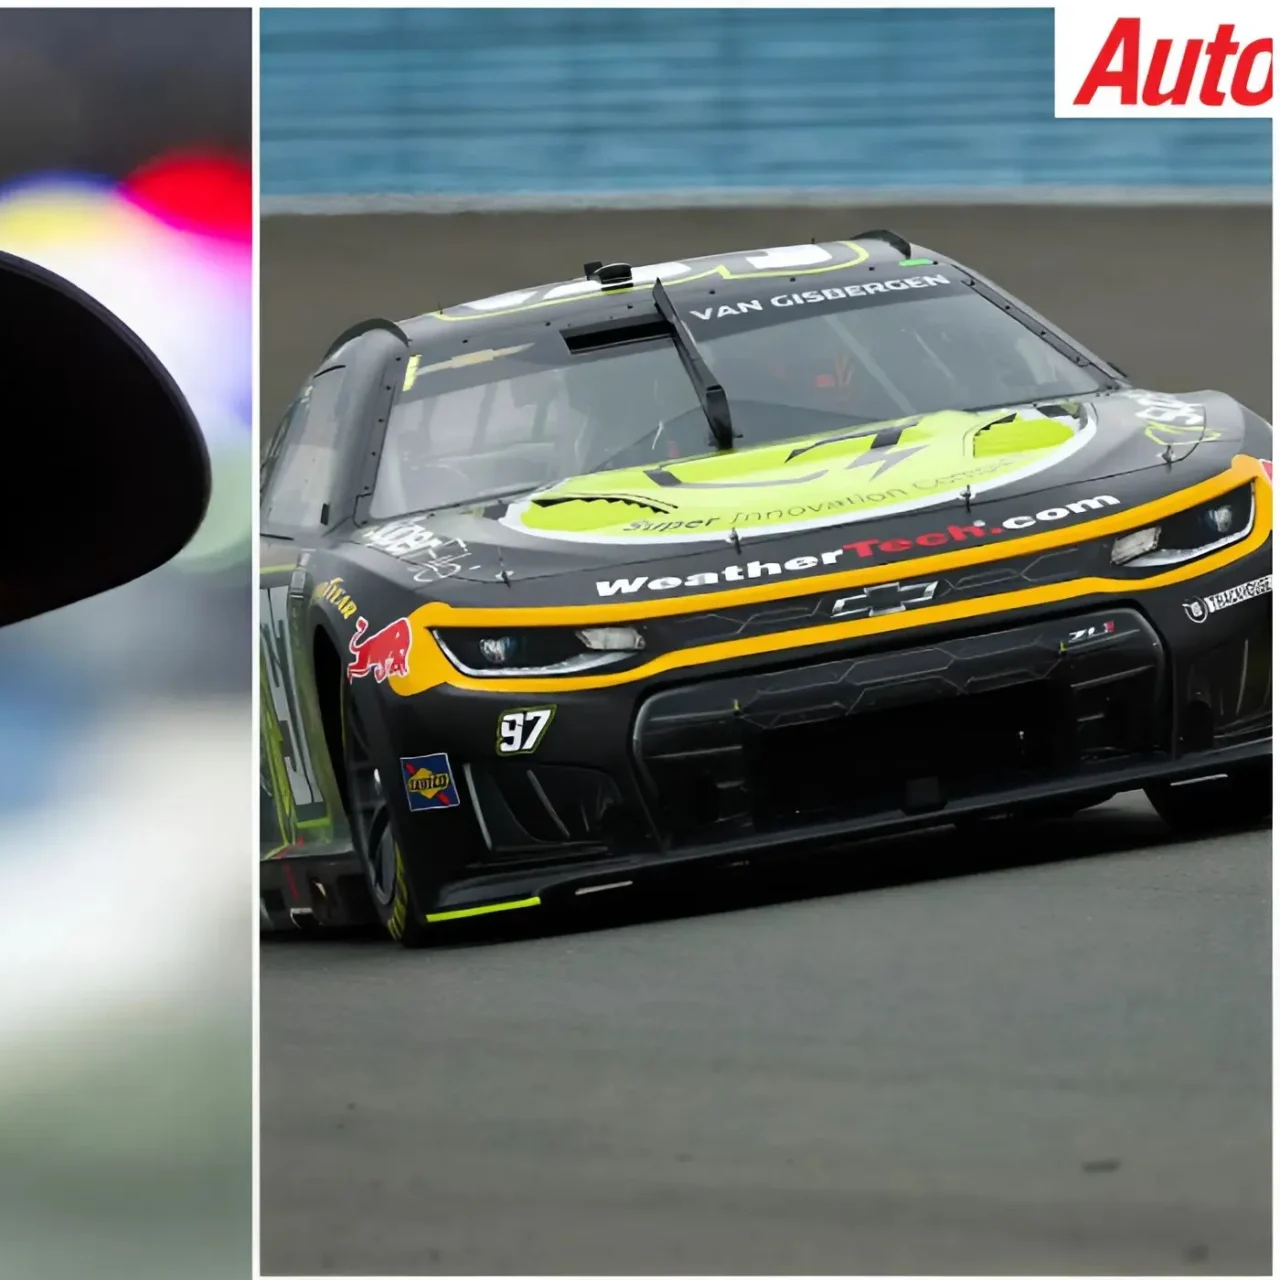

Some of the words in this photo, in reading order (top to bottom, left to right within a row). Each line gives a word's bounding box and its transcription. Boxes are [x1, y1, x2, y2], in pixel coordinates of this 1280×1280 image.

[690, 299, 763, 321] VAN
[770, 274, 951, 307] GISBERGEN
[596, 493, 1121, 597] WeatherTech.com
[500, 709, 552, 752] 97
